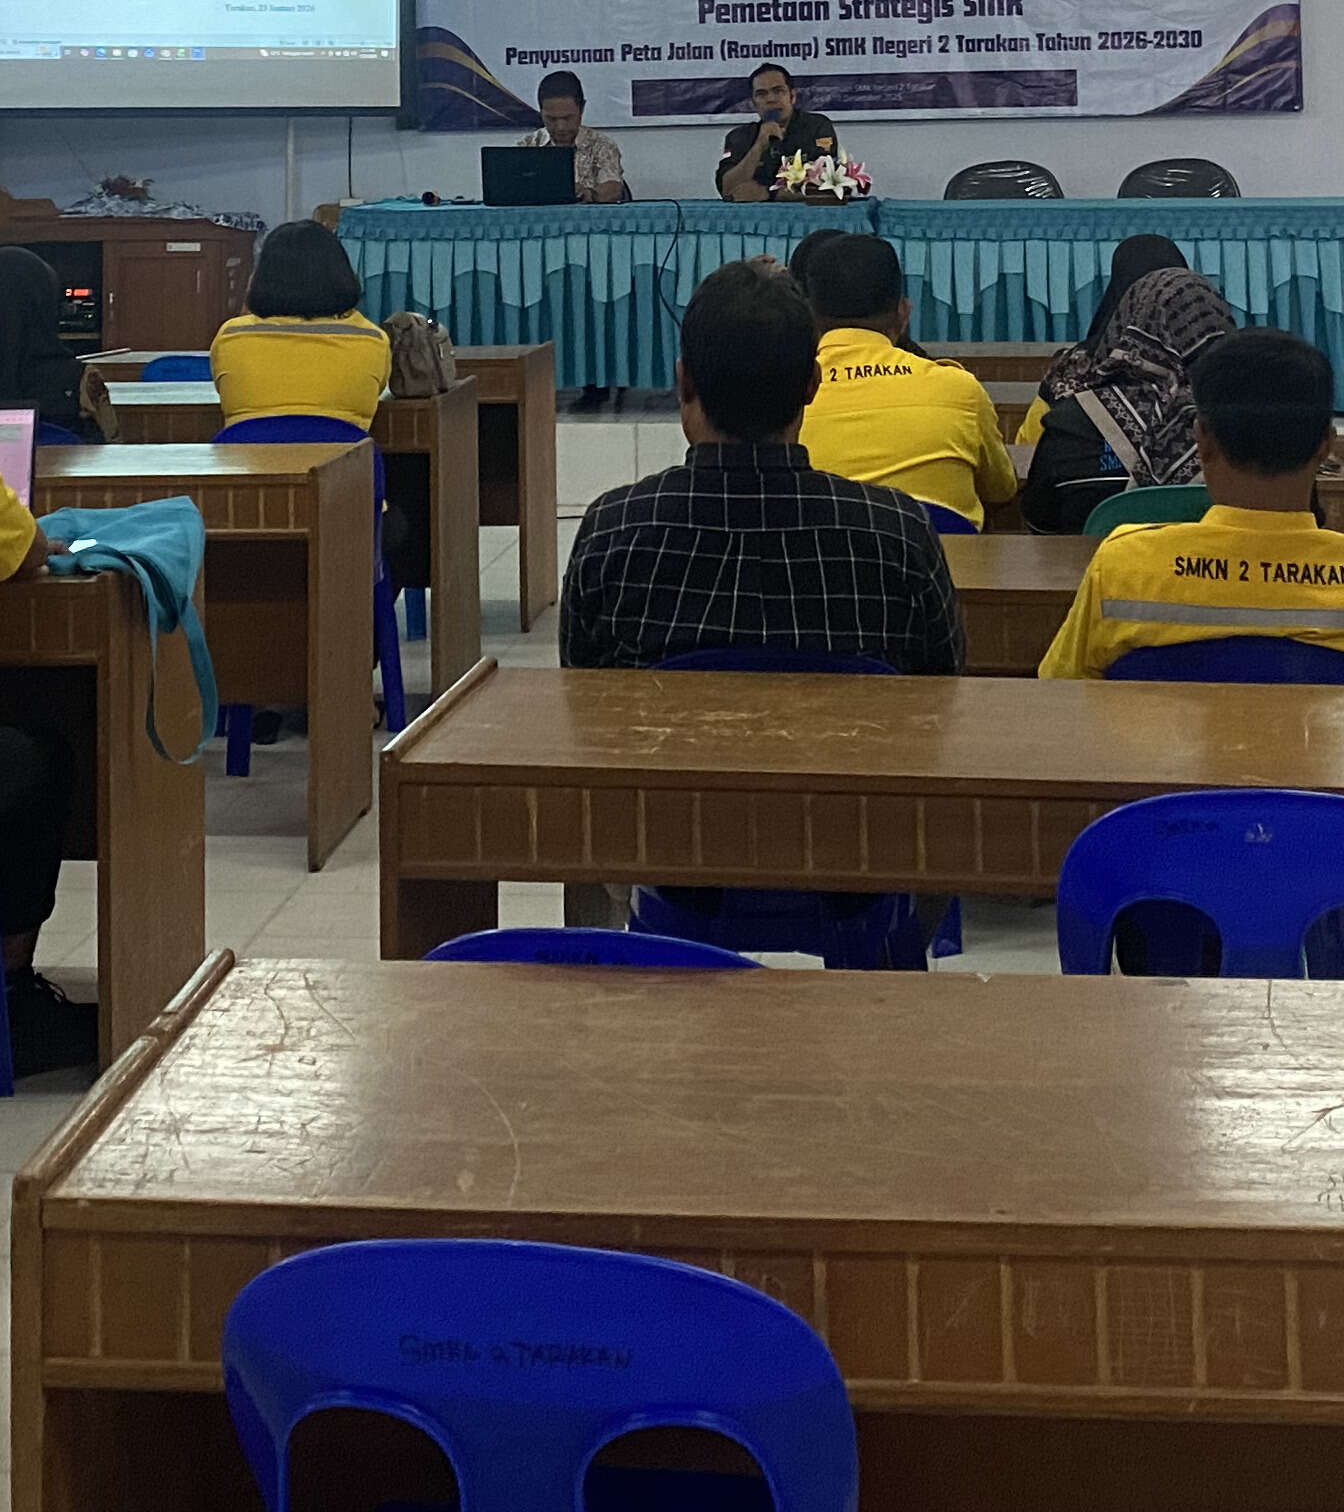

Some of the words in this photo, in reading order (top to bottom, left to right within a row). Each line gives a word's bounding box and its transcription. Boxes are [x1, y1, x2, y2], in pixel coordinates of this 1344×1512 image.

[505, 46, 615, 69] Penyusunan
[620, 42, 662, 62] Peta
[666, 41, 714, 62] Jalan
[719, 36, 820, 62] (Roadmap)
[825, 36, 867, 57] SMK
[872, 34, 933, 59] Negeri
[938, 34, 951, 55] 2
[955, 33, 1031, 54] Tarakan
[1035, 31, 1093, 52] Tahun
[1097, 29, 1204, 51] 2026-2030
[829, 367, 838, 383] 2
[844, 363, 913, 381] TARAKAN
[1173, 555, 1229, 581] SMKN
[1238, 559, 1250, 582] 2
